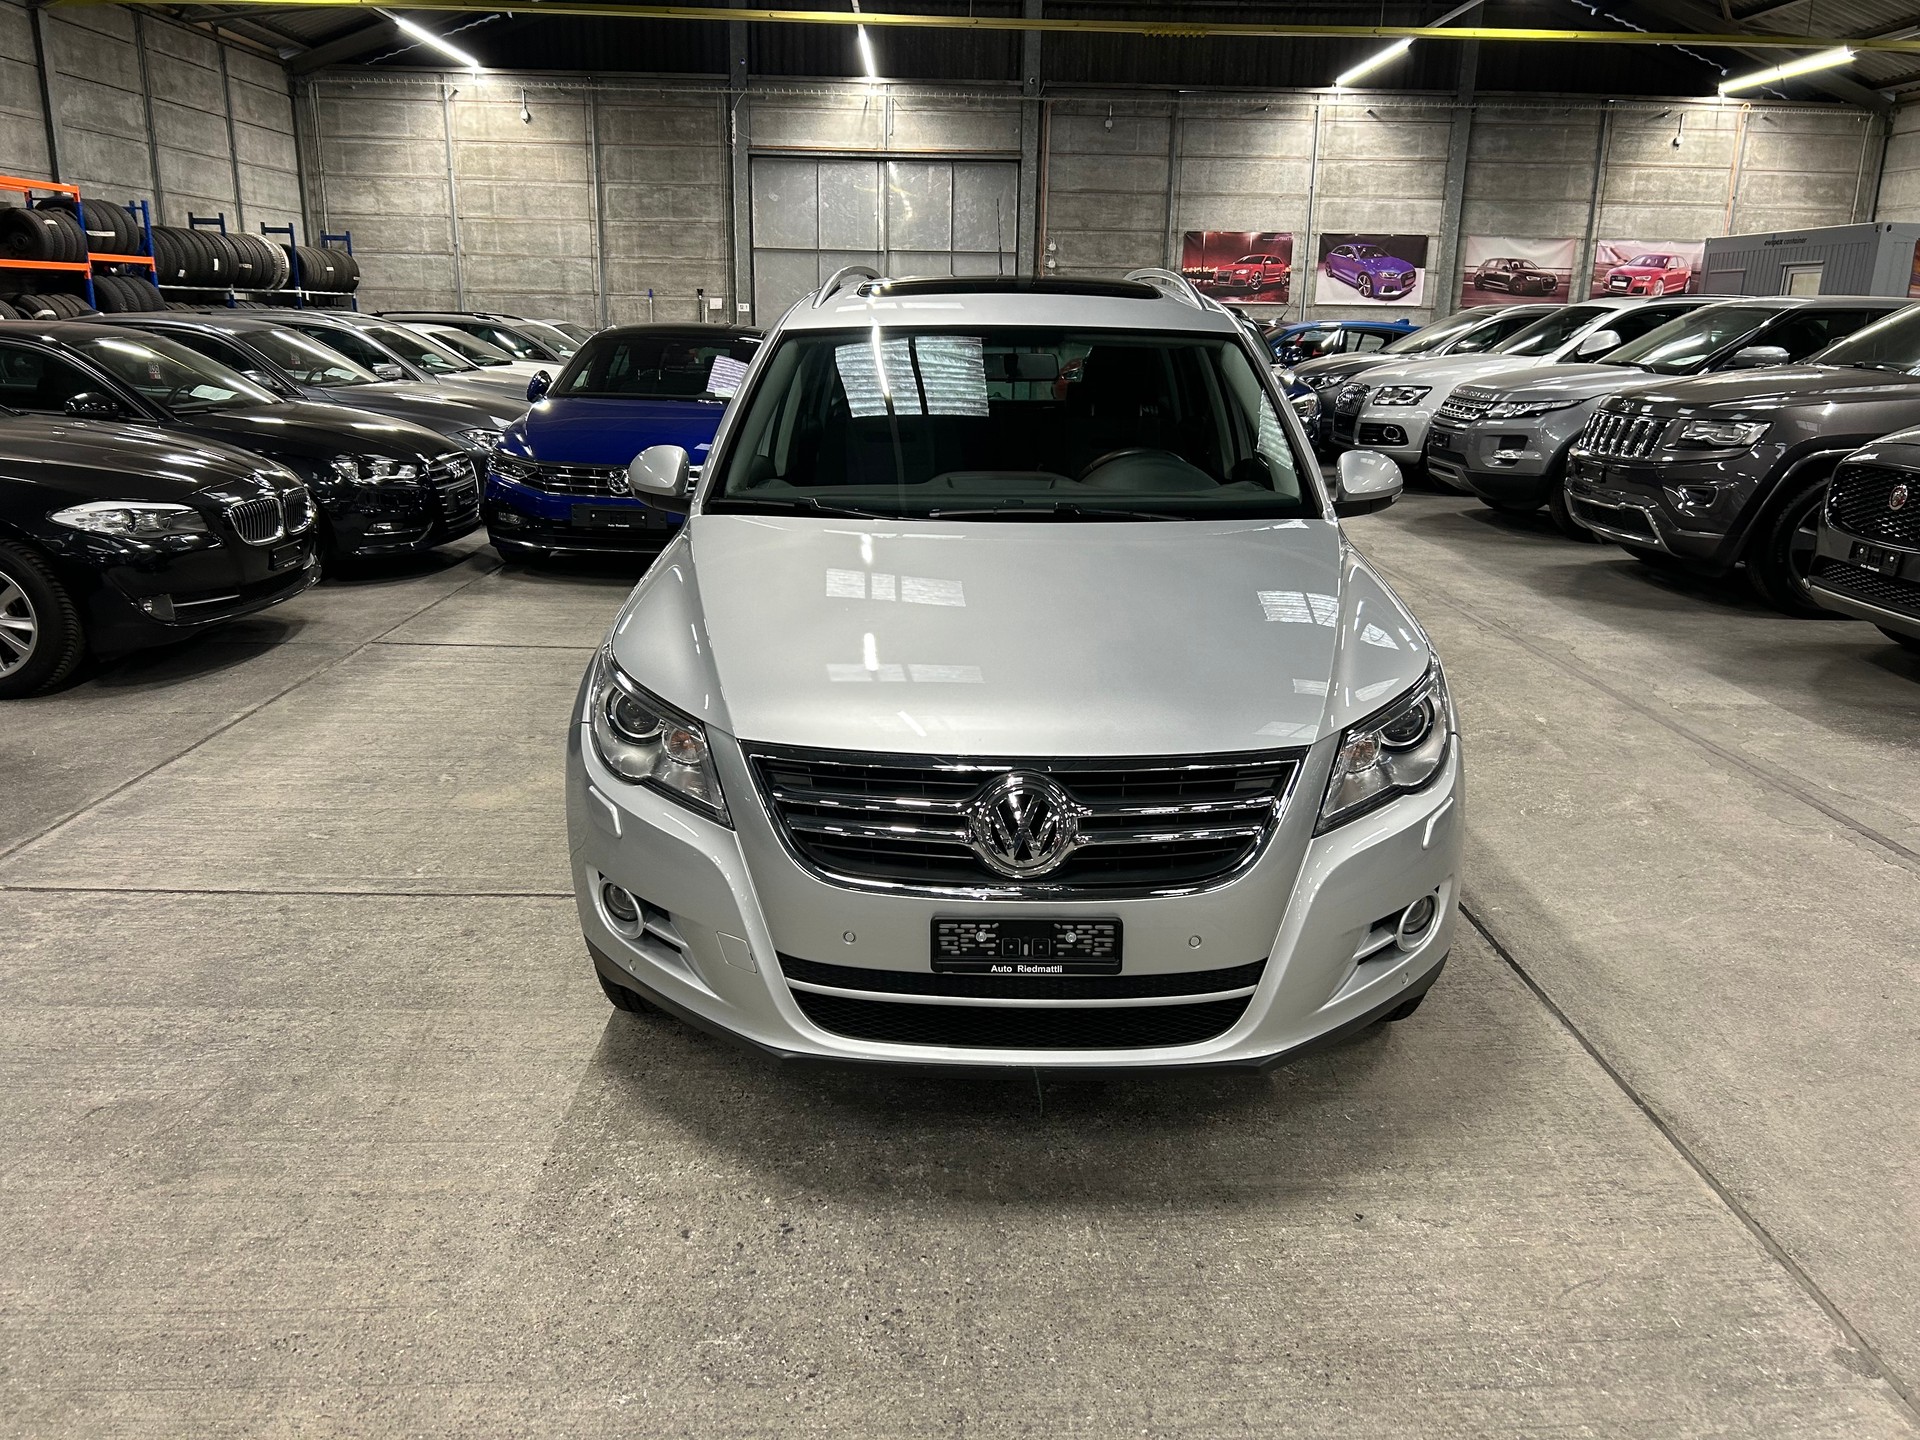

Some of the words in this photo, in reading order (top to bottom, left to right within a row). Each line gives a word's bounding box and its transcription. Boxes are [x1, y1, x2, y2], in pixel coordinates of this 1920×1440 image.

[982, 780, 1064, 868] VW
[991, 965, 1013, 973] Auto
[1017, 965, 1063, 973] Riedmattli
